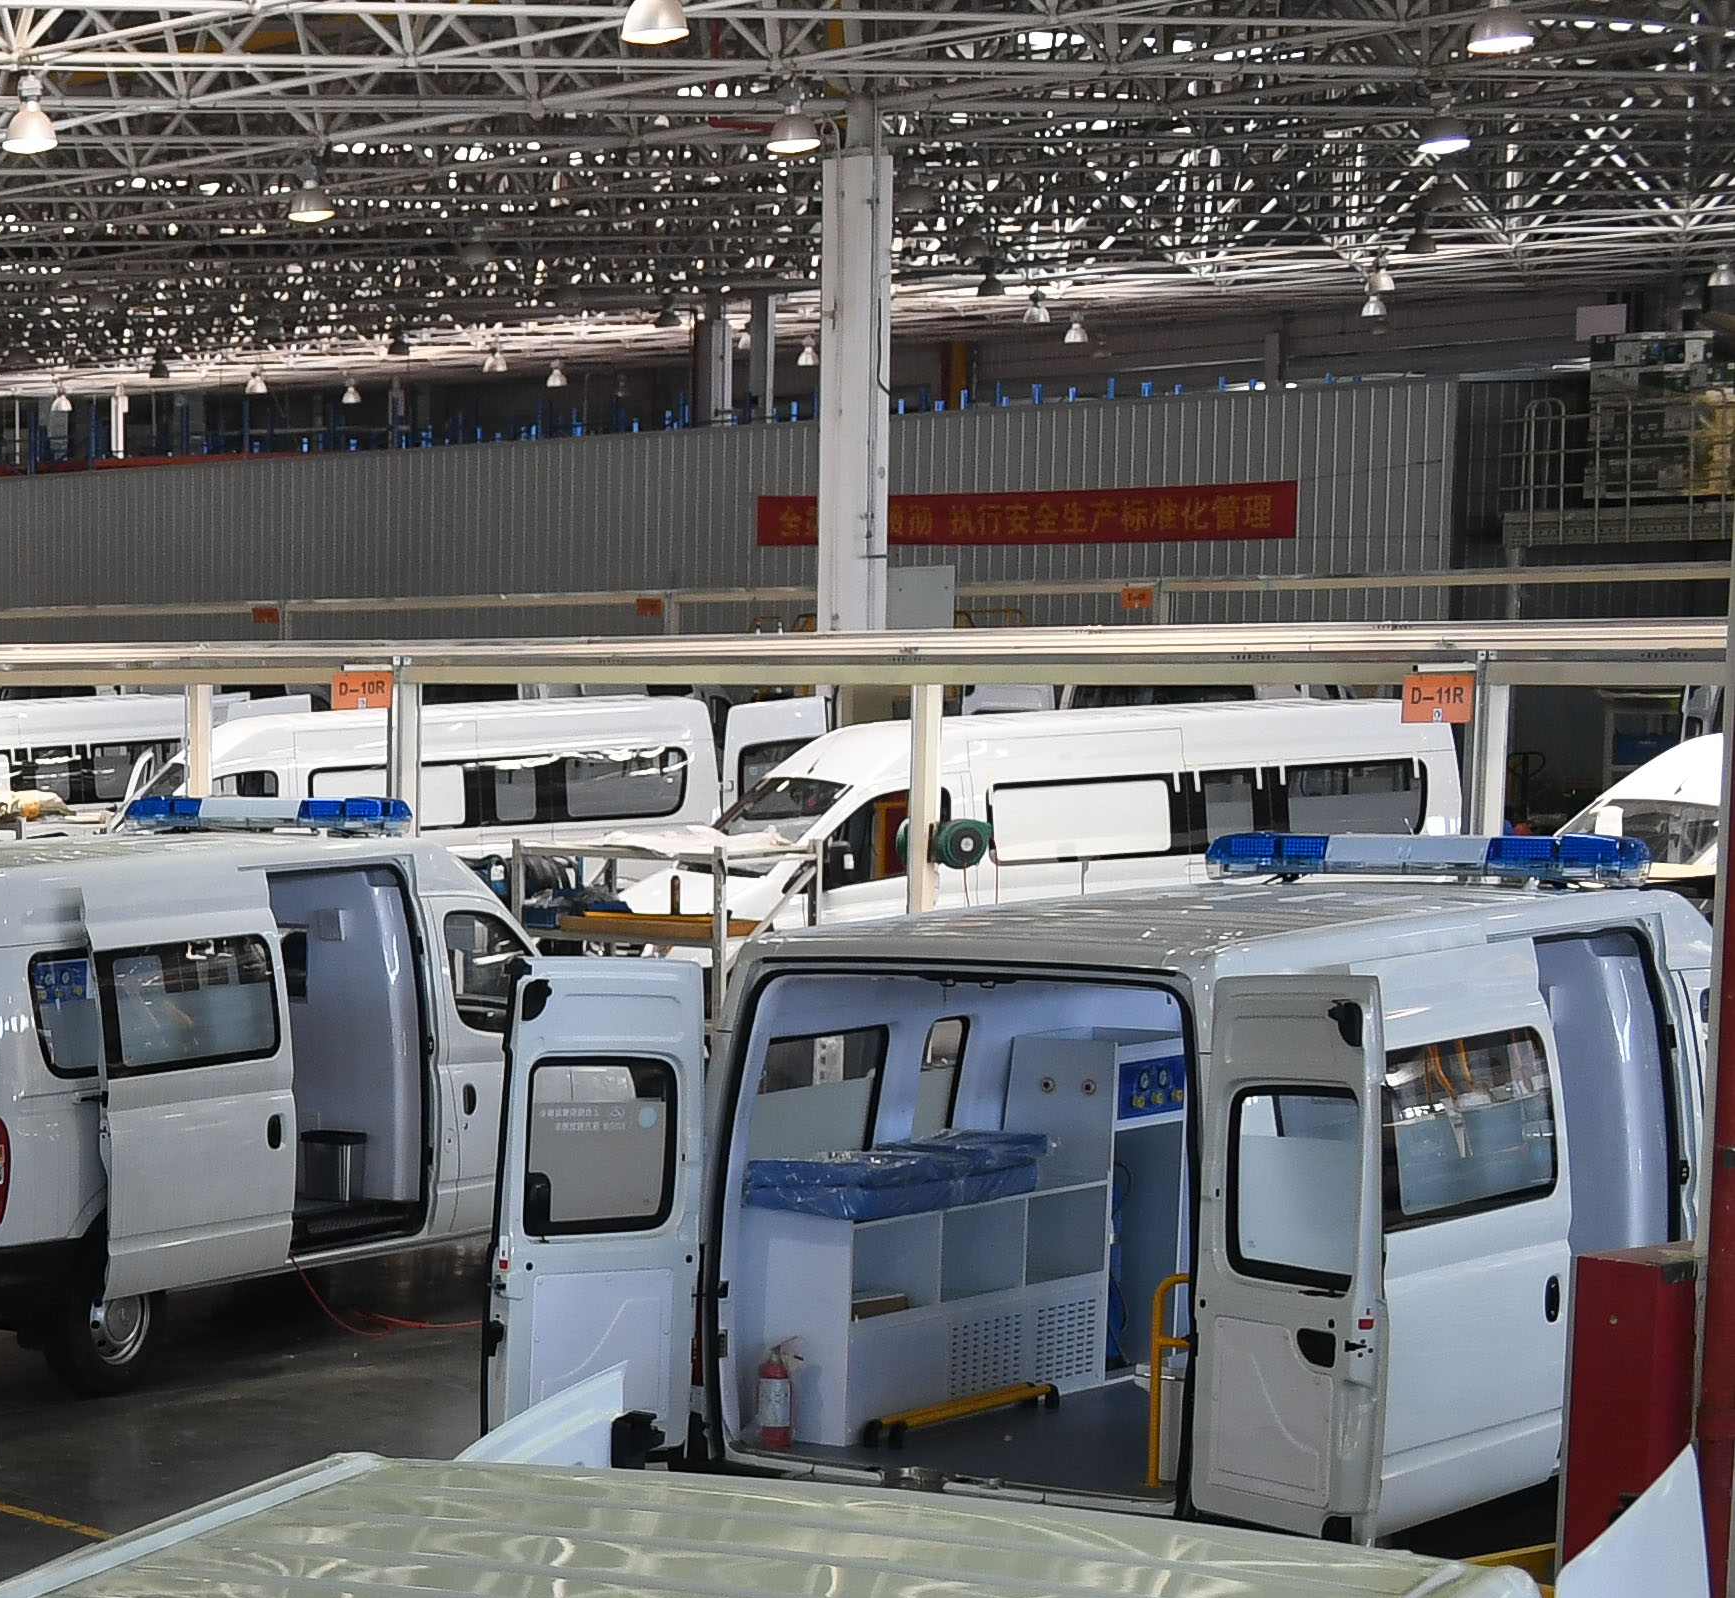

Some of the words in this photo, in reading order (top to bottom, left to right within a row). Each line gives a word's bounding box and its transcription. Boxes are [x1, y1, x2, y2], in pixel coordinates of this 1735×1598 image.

[950, 494, 1274, 536] 执行安全生产标准化管理
[338, 680, 386, 697] D-10R
[1410, 686, 1465, 705] D-11R
